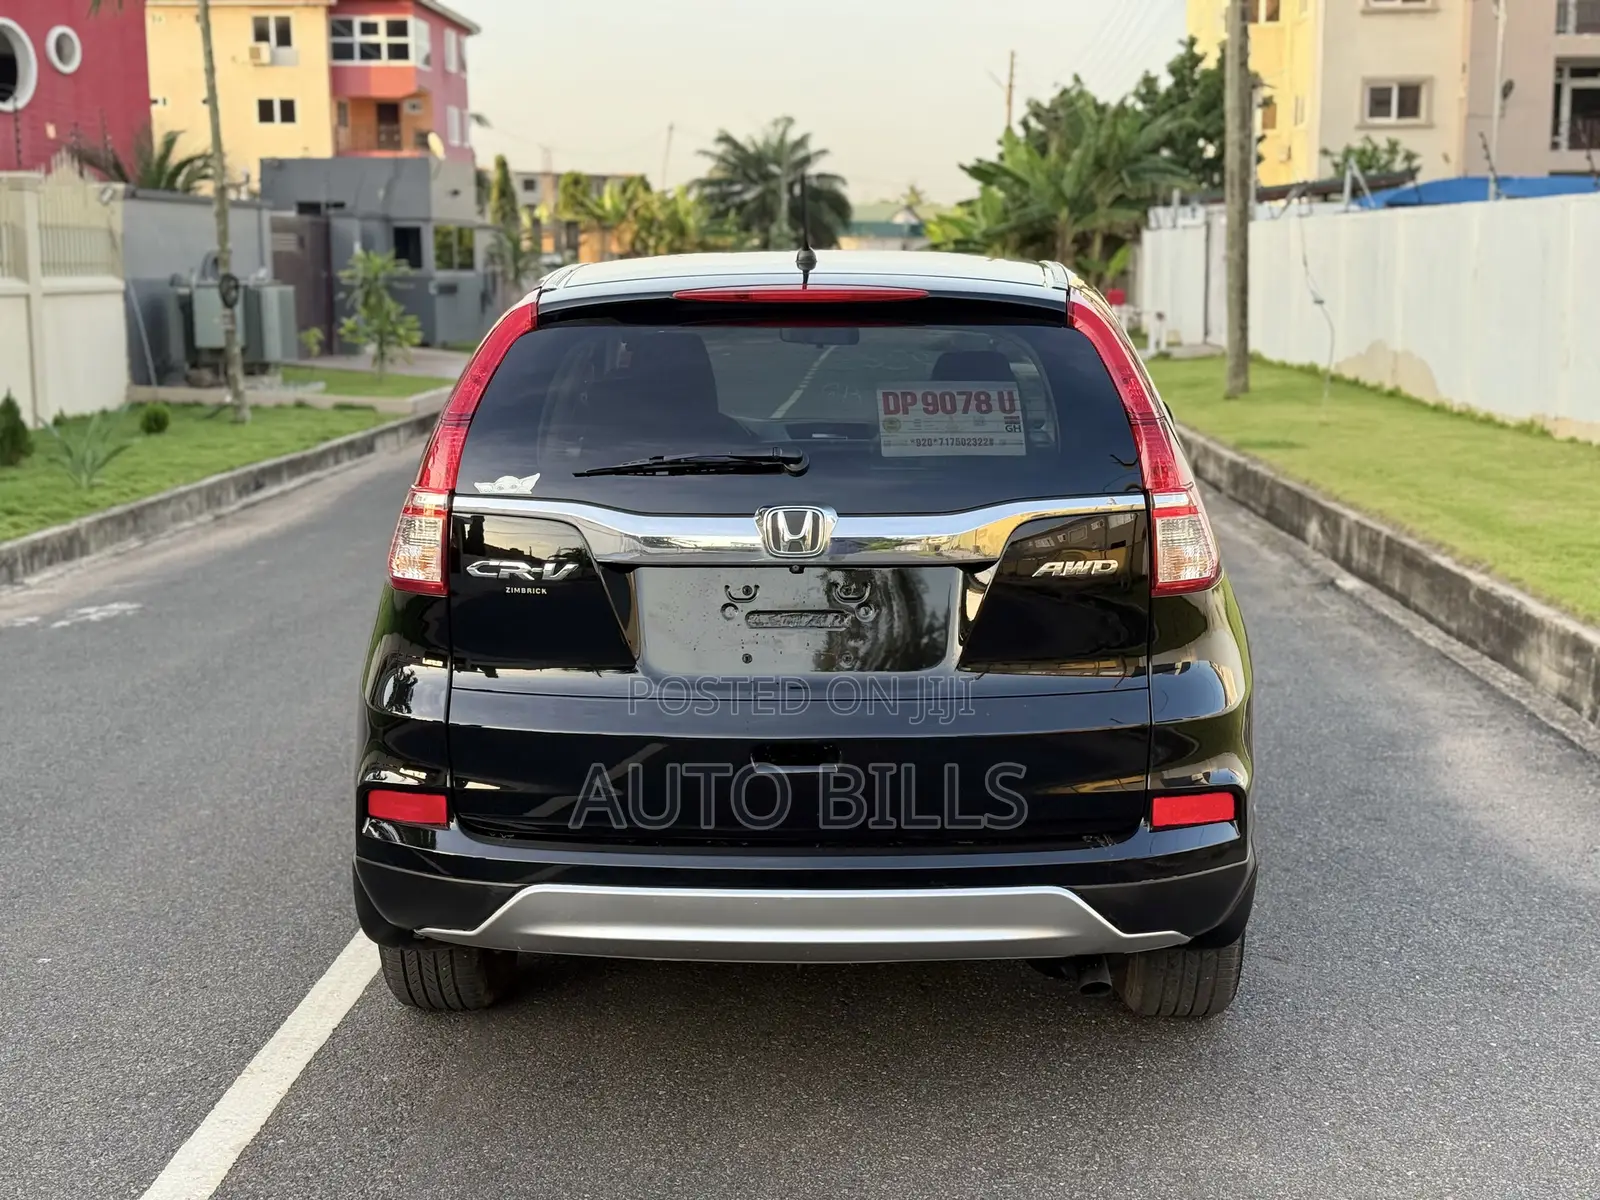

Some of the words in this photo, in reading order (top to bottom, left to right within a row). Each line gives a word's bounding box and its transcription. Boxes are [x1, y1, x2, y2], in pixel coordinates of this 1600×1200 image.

[881, 391, 918, 416] DP
[921, 390, 993, 416] 9078
[997, 390, 1016, 415] U
[1004, 424, 1022, 433] GH
[466, 560, 579, 581] CR-V
[1031, 559, 1119, 578] AWD
[505, 586, 548, 595] ZIMBRICK
